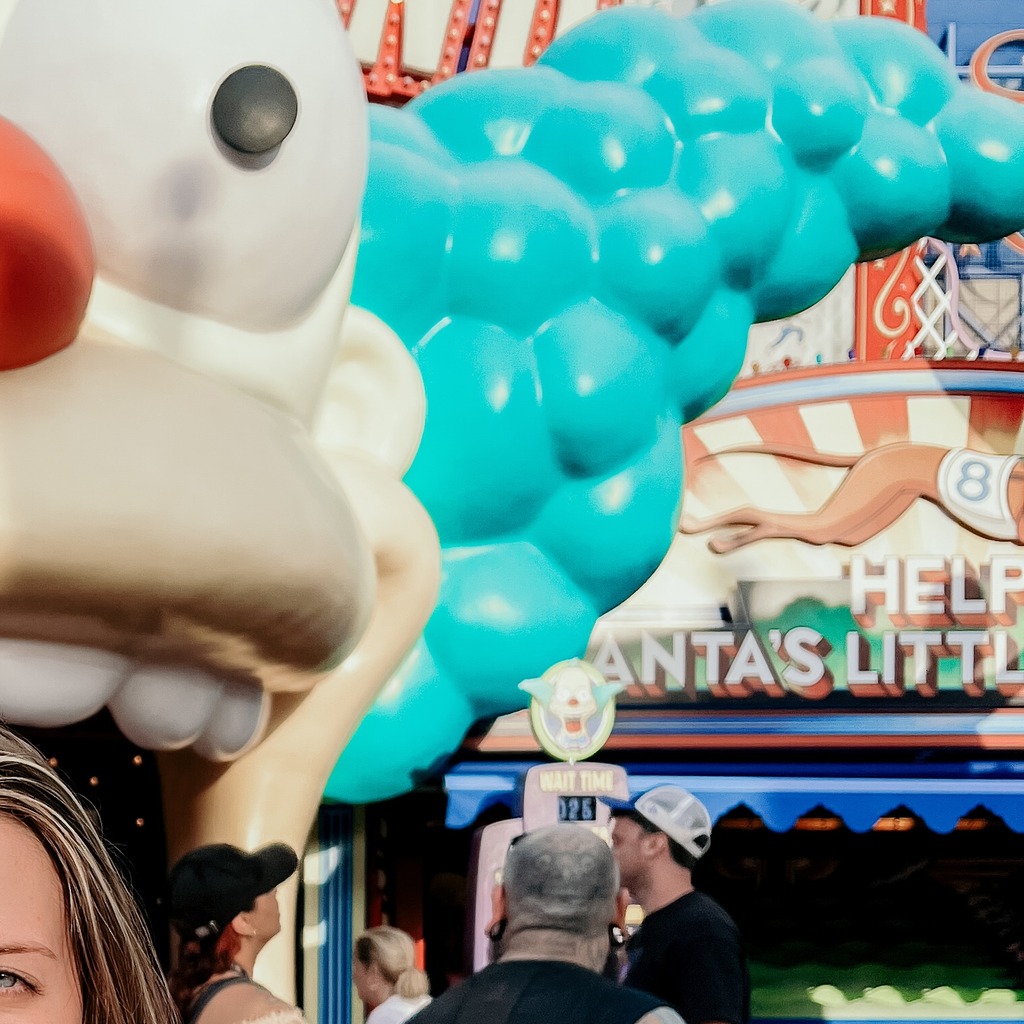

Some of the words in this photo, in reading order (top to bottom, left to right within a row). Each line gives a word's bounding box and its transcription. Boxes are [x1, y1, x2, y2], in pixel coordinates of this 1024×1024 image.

[956, 460, 991, 502] 8
[851, 554, 1024, 621] HELP
[590, 626, 827, 692] ANTA'S
[846, 629, 1024, 692] LITTL
[539, 769, 576, 793] WAIT
[579, 769, 614, 793] TIME
